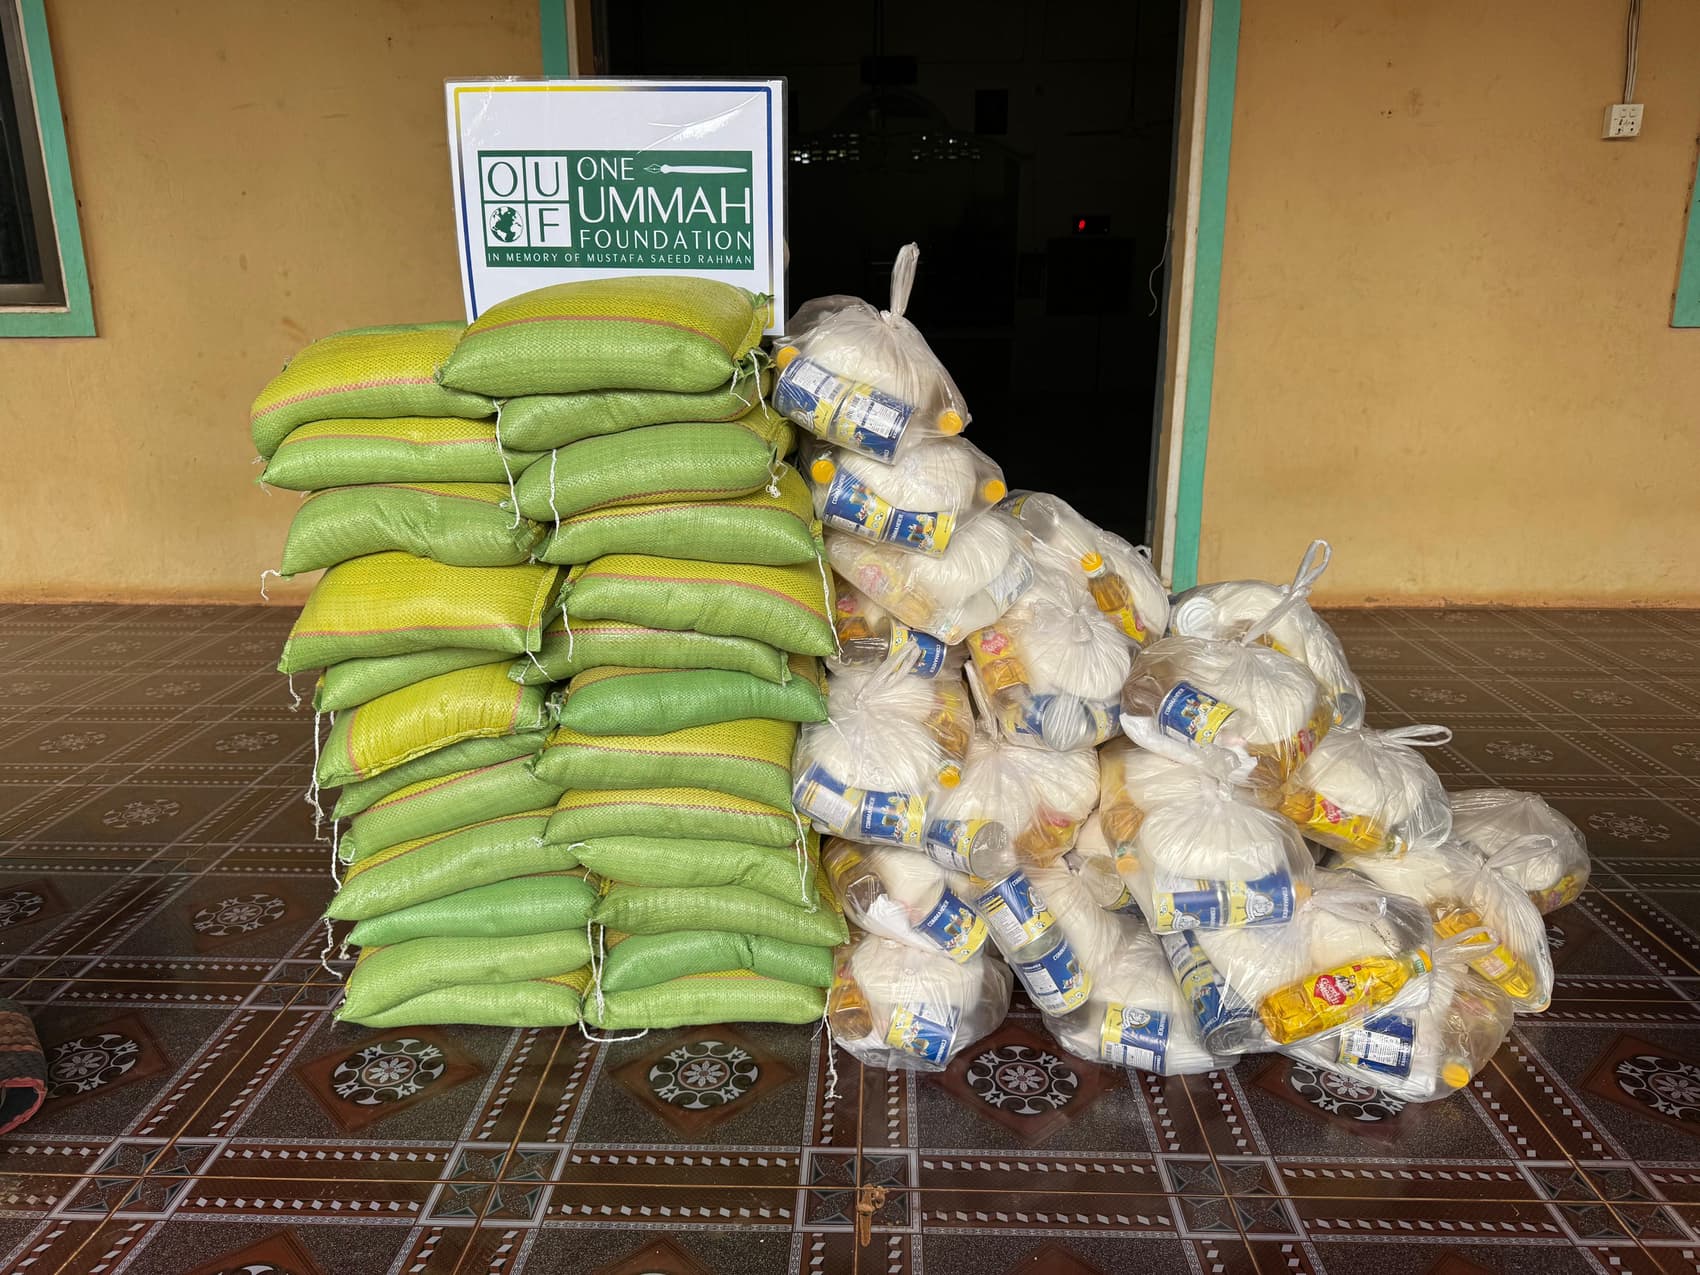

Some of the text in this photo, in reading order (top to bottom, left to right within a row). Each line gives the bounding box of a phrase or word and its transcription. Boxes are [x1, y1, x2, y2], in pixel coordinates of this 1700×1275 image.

[487, 161, 560, 197] O U
[577, 156, 635, 181] ONE
[578, 186, 751, 224] UMMAH
[538, 207, 560, 243] F
[580, 228, 751, 250] FOUNDATION
[487, 252, 752, 265] IN MEMORY OF MUSTAFA SAEED RAHMAN
[926, 900, 950, 928] COMMANDER
